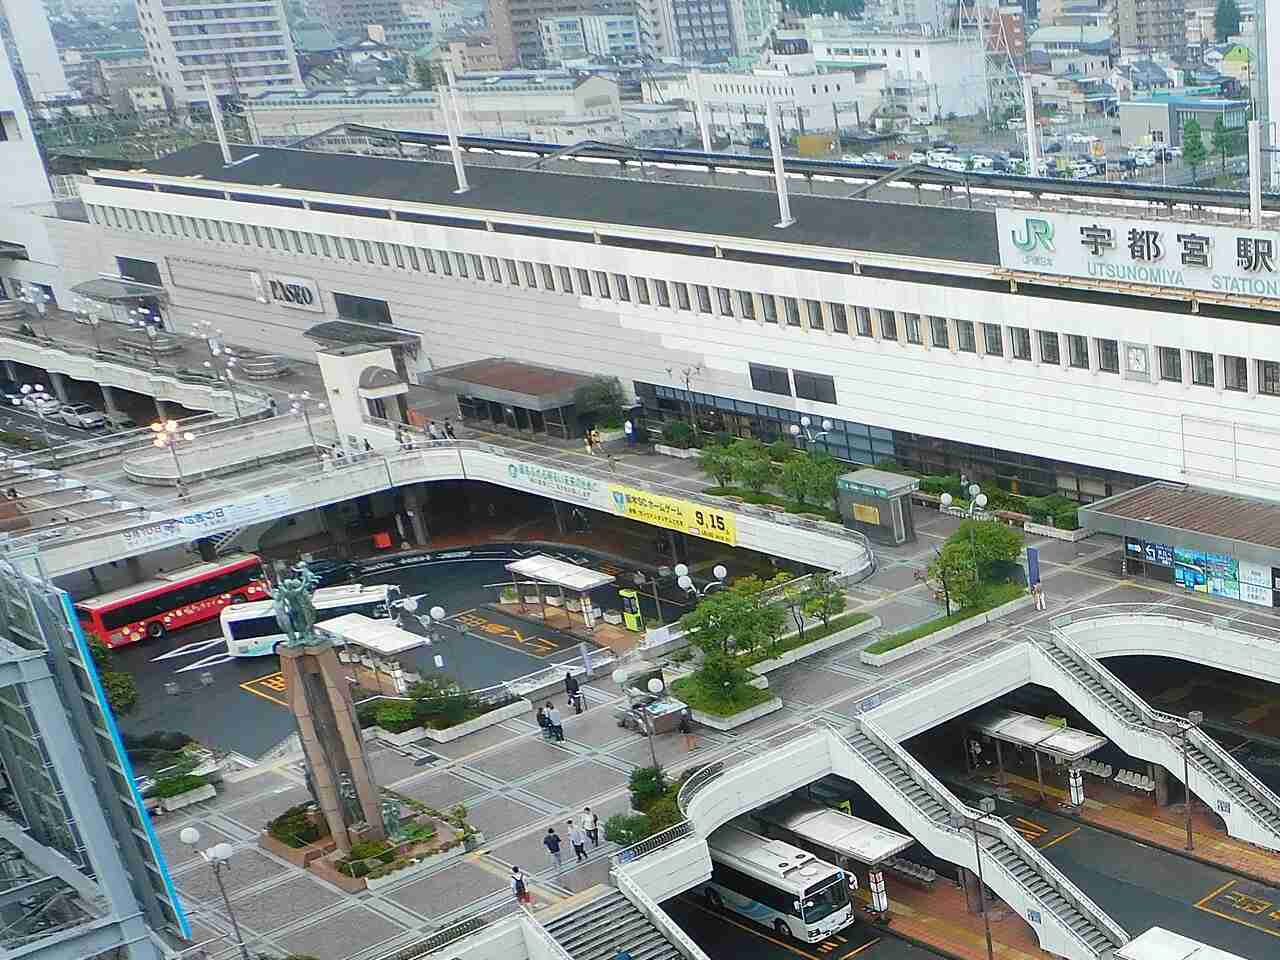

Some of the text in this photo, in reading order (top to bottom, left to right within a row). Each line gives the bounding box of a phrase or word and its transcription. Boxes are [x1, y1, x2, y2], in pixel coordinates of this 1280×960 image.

[1011, 217, 1056, 253] JR
[1079, 224, 1276, 273] 宇都宮駅
[1086, 260, 1279, 296] UTSUNOMIYA STATION
